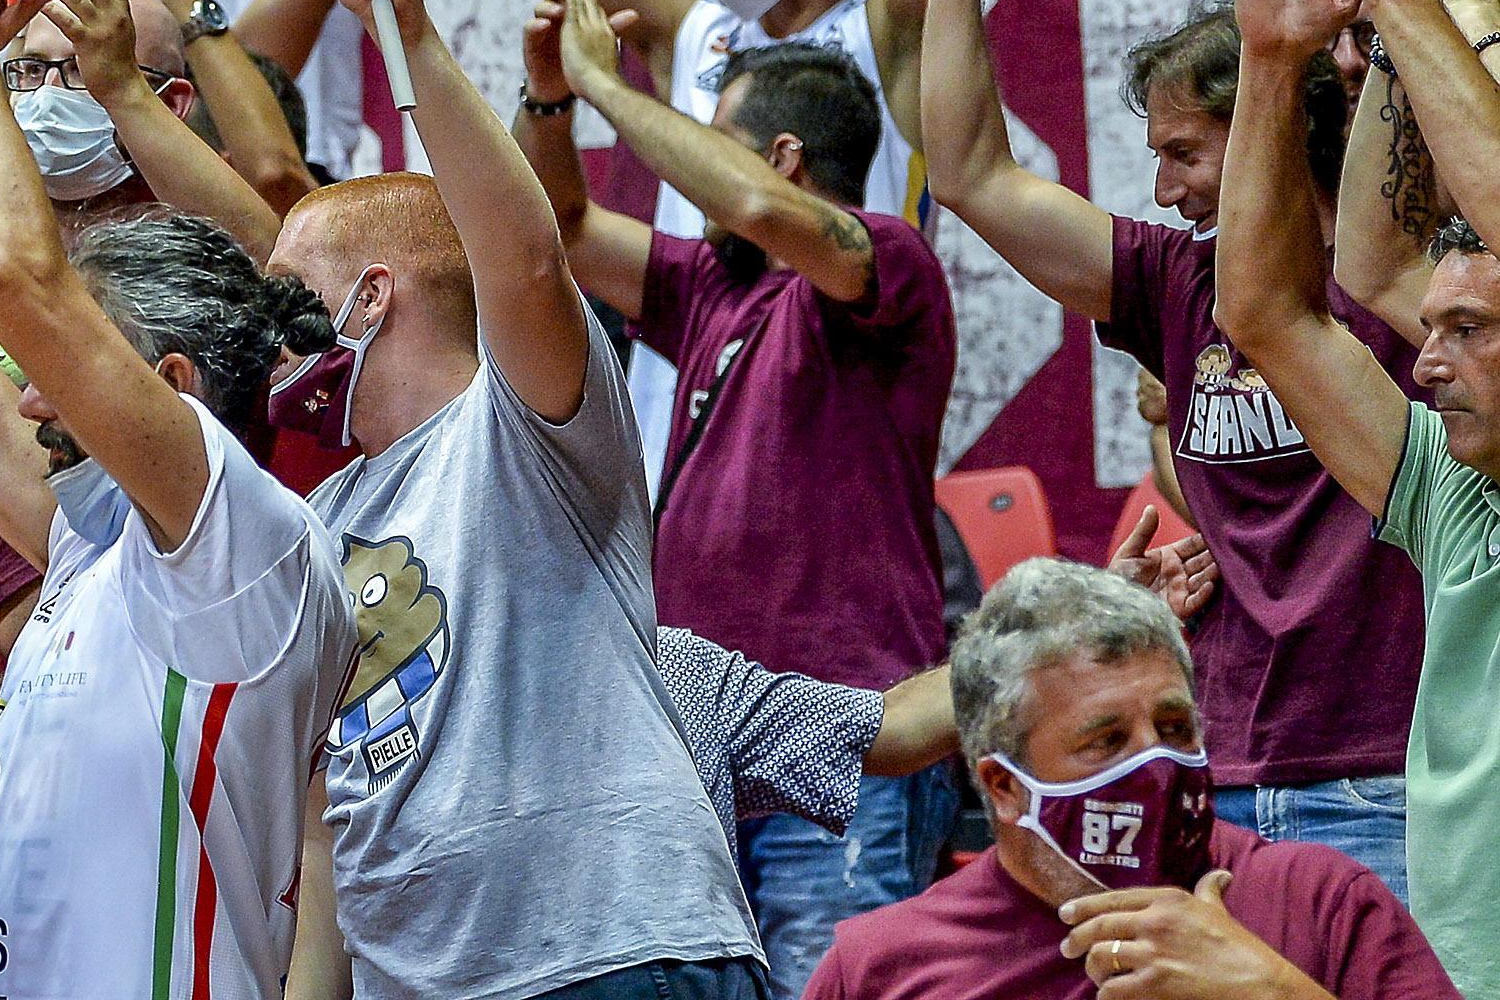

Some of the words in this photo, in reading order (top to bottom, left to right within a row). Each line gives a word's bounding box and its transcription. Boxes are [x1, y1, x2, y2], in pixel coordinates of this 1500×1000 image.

[58, 672, 88, 687] LIFE
[370, 730, 413, 768] PIELLE
[1081, 811, 1143, 855] 87
